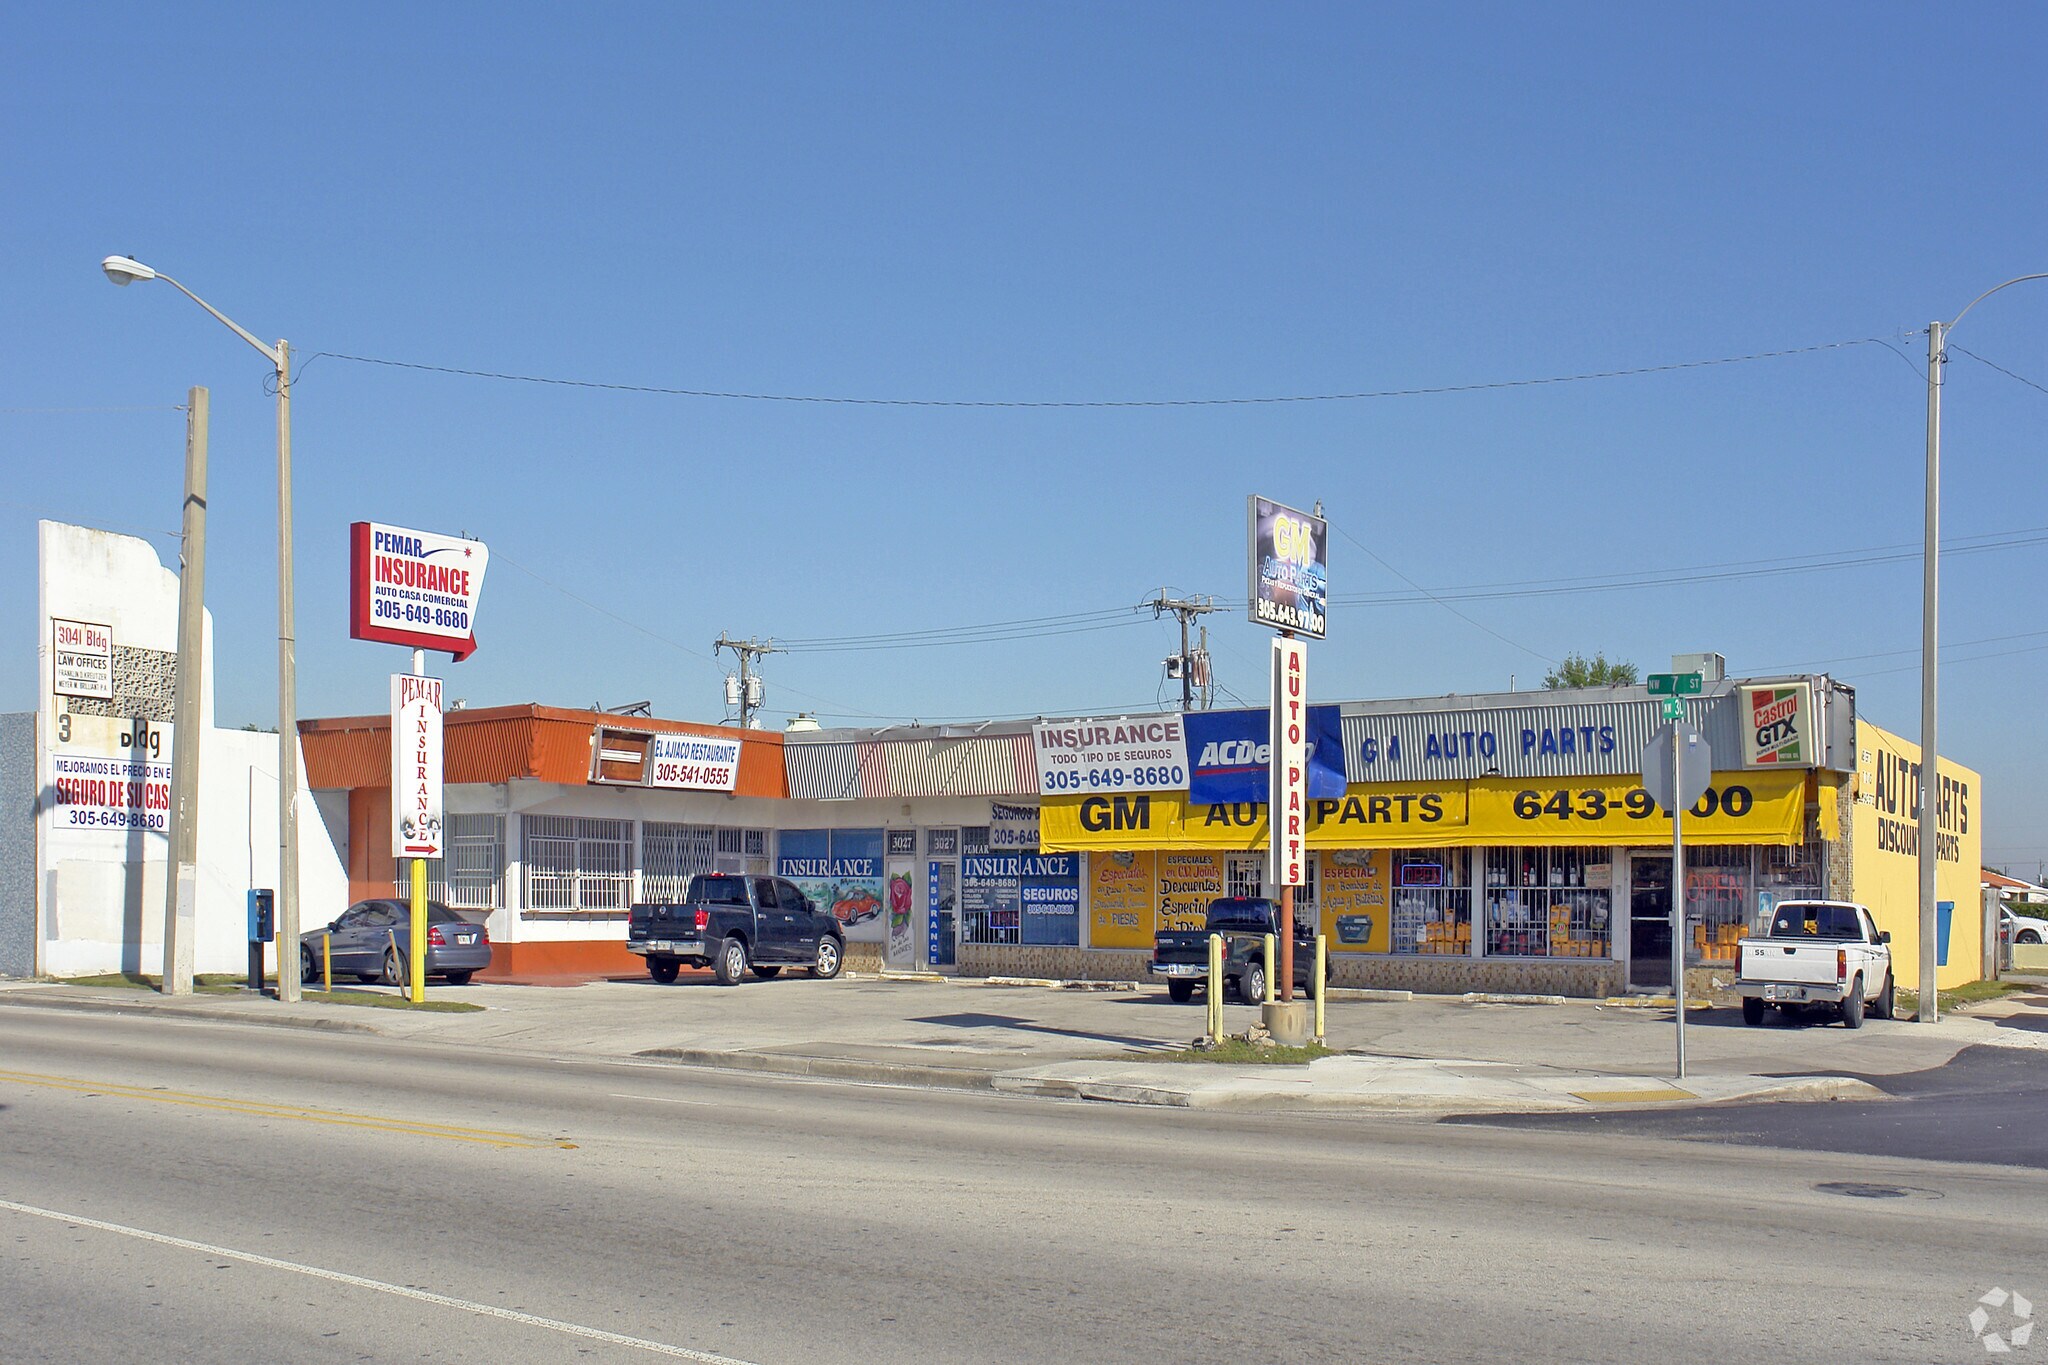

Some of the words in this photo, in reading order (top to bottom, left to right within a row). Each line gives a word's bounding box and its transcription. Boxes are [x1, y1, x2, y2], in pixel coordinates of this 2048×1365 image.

[375, 531, 423, 558] PEMAR
[1273, 516, 1312, 565] GM
[375, 555, 470, 596] INSURANCE
[1263, 555, 1288, 580] AUTO
[1290, 564, 1319, 590] PARTS
[375, 586, 398, 598] AUTO
[399, 589, 421, 601] CASA
[422, 593, 469, 609] COMERCIAL
[375, 599, 469, 629] 305-649-8680
[86, 630, 107, 652] Bldg
[58, 654, 74, 667] LAW
[76, 657, 107, 670] OFFICES
[1648, 679, 1660, 690] NW
[1670, 675, 1679, 693] 7
[1689, 678, 1700, 689] ST
[401, 677, 442, 715] PEMAR
[1288, 651, 1300, 746] AUTO
[1753, 694, 1798, 729] Castrol
[1039, 722, 1182, 750] INSURANCE
[1756, 713, 1798, 748] GTX
[655, 740, 664, 758] EL
[664, 740, 690, 760] AJIACO
[690, 742, 737, 764] RESTAURANTE
[1198, 740, 1316, 767] ACDeo
[1426, 730, 1496, 760] AUTO
[1522, 726, 1615, 756] PARTS
[1050, 753, 1078, 766] TODO
[1106, 751, 1122, 763] DE
[1123, 748, 1173, 761] SEGUROS
[56, 760, 109, 776] MEJORAMOS
[110, 763, 121, 776] EL
[122, 764, 151, 779] PRECIO
[153, 766, 164, 779] EN
[417, 704, 428, 842] INSURANCE
[1045, 764, 1184, 791] 305-649-8680
[56, 776, 105, 806] SEGURO
[109, 780, 124, 808] DE
[126, 781, 143, 809] SU
[144, 782, 171, 811] CAS
[1876, 749, 1921, 820] AUTO
[1936, 772, 1968, 834] ARTS
[69, 809, 164, 829] 305-649-8680
[992, 805, 1033, 821] SEGUROS
[1079, 795, 1151, 833] GM
[1204, 802, 1311, 827] AU
[1317, 794, 1444, 826] PARTS
[1512, 785, 1753, 821] 643-900
[1289, 766, 1300, 884] PARTS
[891, 836, 913, 849] 3027
[934, 837, 955, 850] 3027
[993, 828, 1040, 846] 305-649
[1878, 817, 1920, 856] DISCOUN
[1936, 832, 1960, 865] PARTS
[963, 844, 989, 855] PEMAR
[1167, 855, 1213, 865] ESPECIALES
[781, 858, 874, 877] INSURANCE
[964, 856, 1069, 876] INSURANCE
[1166, 868, 1175, 878] en
[1324, 867, 1373, 878] ESPECIAL
[964, 877, 1017, 888] 305-649-8680
[1159, 878, 1222, 895] Descuentos
[1685, 873, 1744, 903] OPEN
[1023, 888, 1079, 902] SEGUROS
[930, 862, 938, 964] INSURANCE
[1027, 904, 1075, 915] 305-649-8680
[1111, 912, 1139, 926] PIESAS
[1160, 897, 1211, 918] Especial
